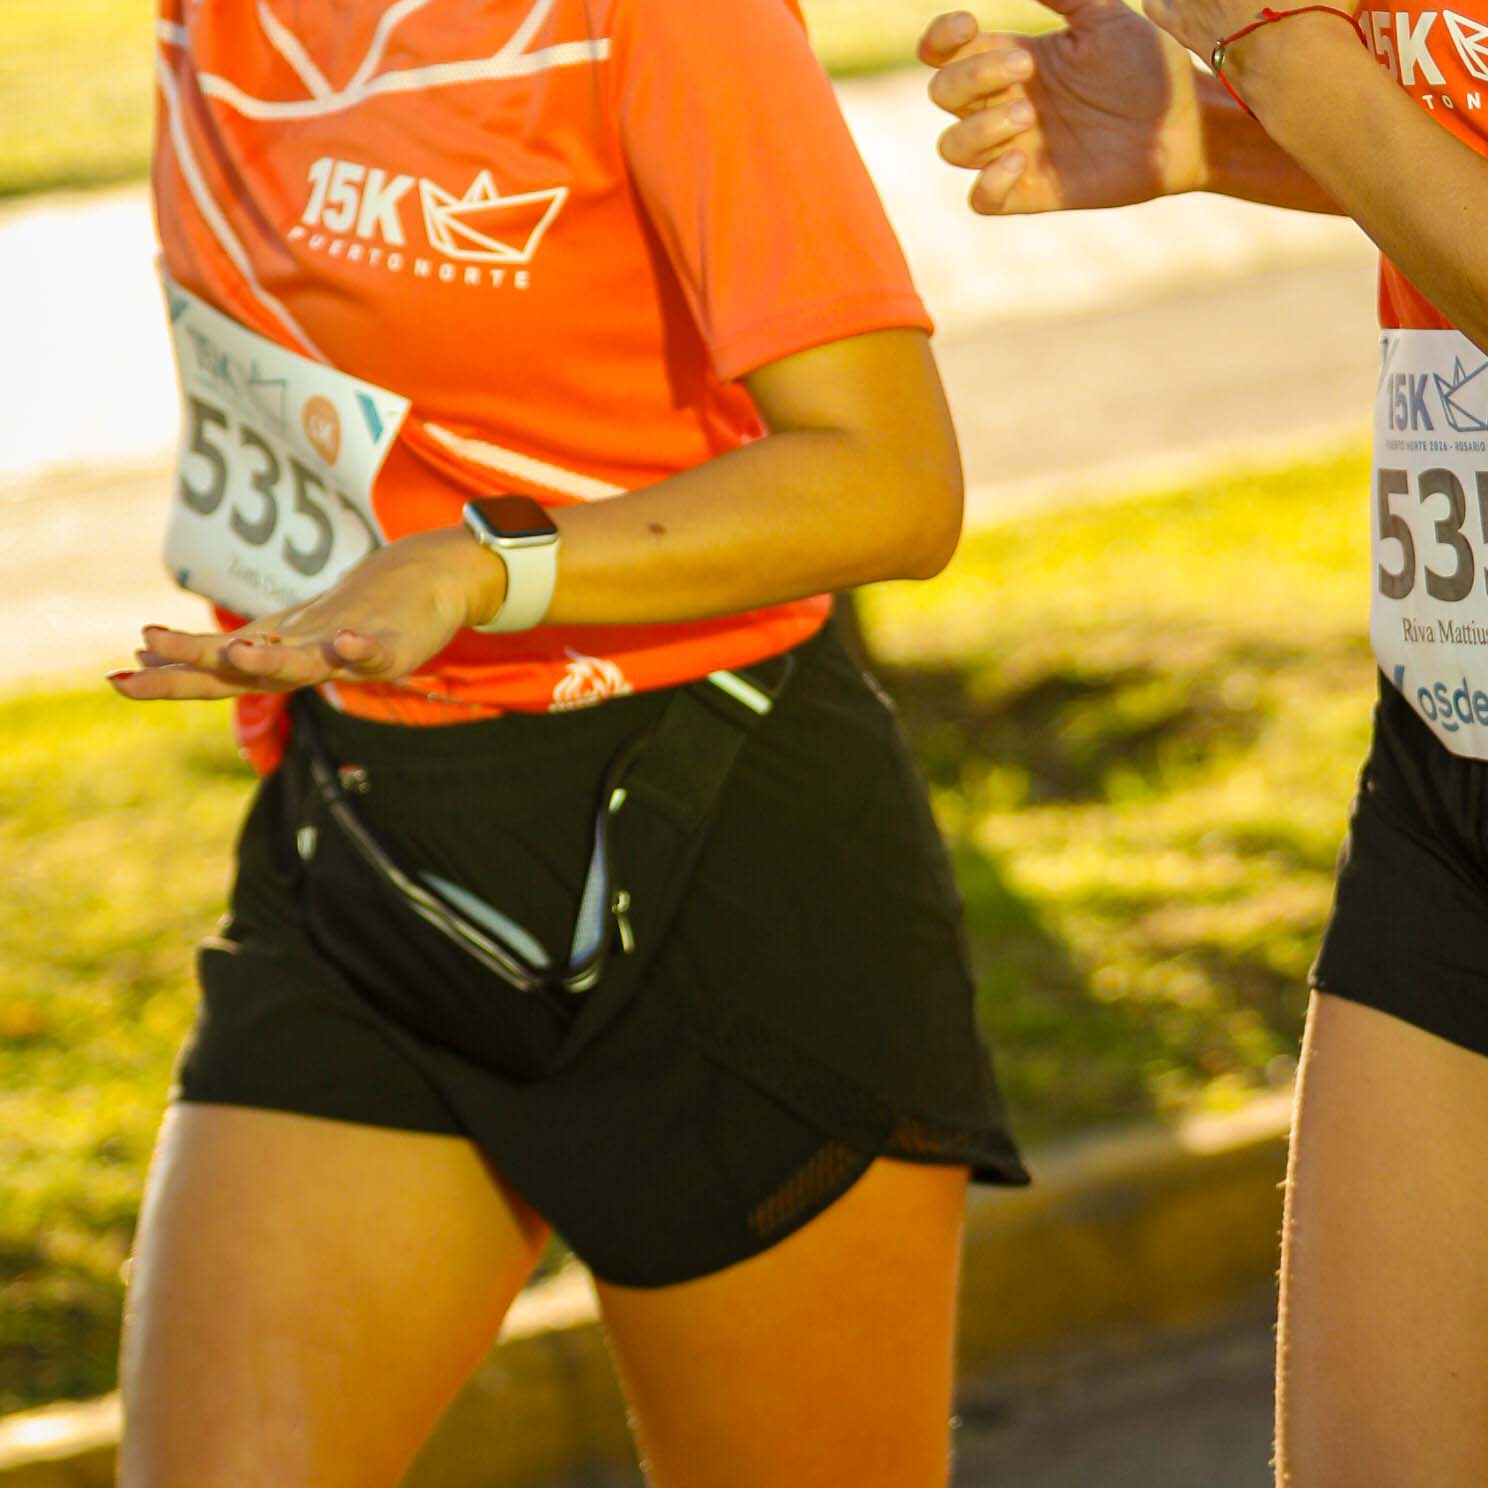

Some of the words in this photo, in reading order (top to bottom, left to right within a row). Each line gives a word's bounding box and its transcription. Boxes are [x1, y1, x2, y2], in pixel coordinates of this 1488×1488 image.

[300, 156, 417, 247] 15K
[287, 224, 402, 273] PUERTO
[413, 257, 531, 291] NORTE
[1387, 372, 1435, 432] 15K
[1429, 441, 1448, 452] 2026
[1455, 441, 1486, 453] ROSARIO
[180, 393, 385, 578] 535
[1402, 617, 1436, 644] Riva
